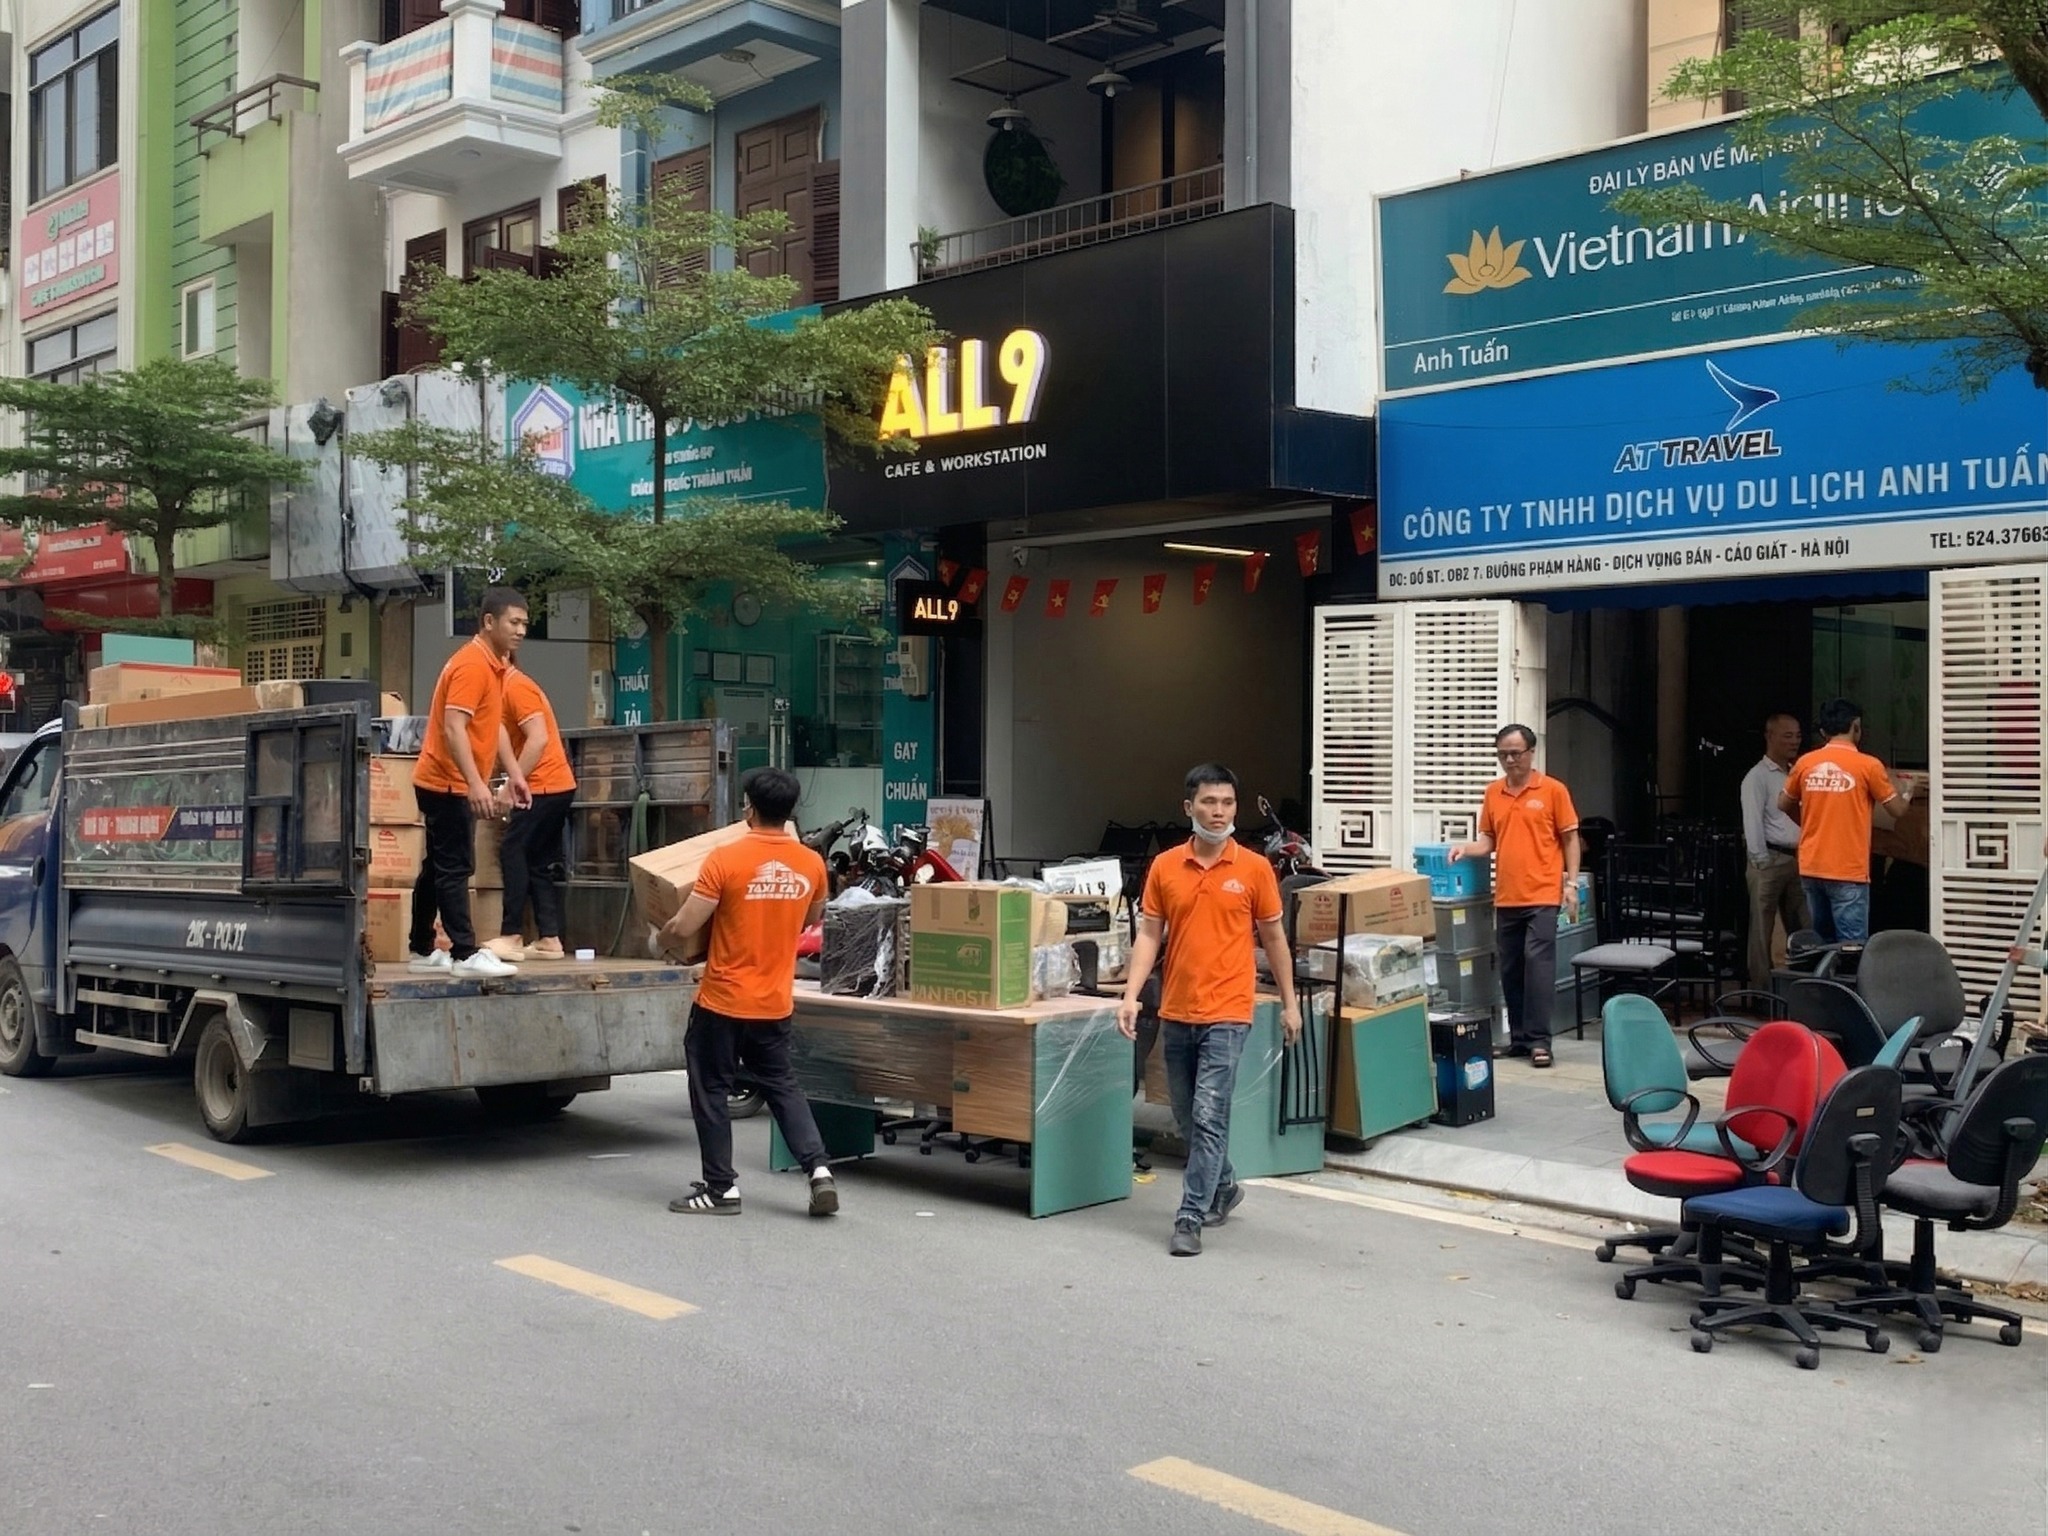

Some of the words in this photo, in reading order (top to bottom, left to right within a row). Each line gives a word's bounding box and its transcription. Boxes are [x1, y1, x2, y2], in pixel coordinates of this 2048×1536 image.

[1588, 170, 1621, 196] ĐẠI
[1532, 219, 1732, 279] Vietnam
[1413, 347, 1454, 374] Anh
[1457, 337, 1510, 367] Tuấn
[884, 461, 921, 479] CAFE
[924, 460, 936, 474] &
[940, 443, 1047, 472] WORKSTATION
[1613, 442, 1660, 474] AT
[1661, 428, 1783, 468] TRAVEL
[1403, 505, 1472, 541] CÔNG
[1480, 503, 1513, 533] TY
[1520, 495, 1595, 529] TNHH
[1606, 486, 1675, 525] DỊCH
[1685, 483, 1725, 518] VỤ
[1737, 478, 1778, 510] DU
[1791, 470, 1865, 509] LỊCH
[1878, 461, 1949, 498] ANH
[1529, 559, 1564, 578] PHẠM
[1612, 553, 1643, 572] DỊCH
[1800, 538, 1821, 558] HÀ
[1930, 532, 1962, 549] TEL:
